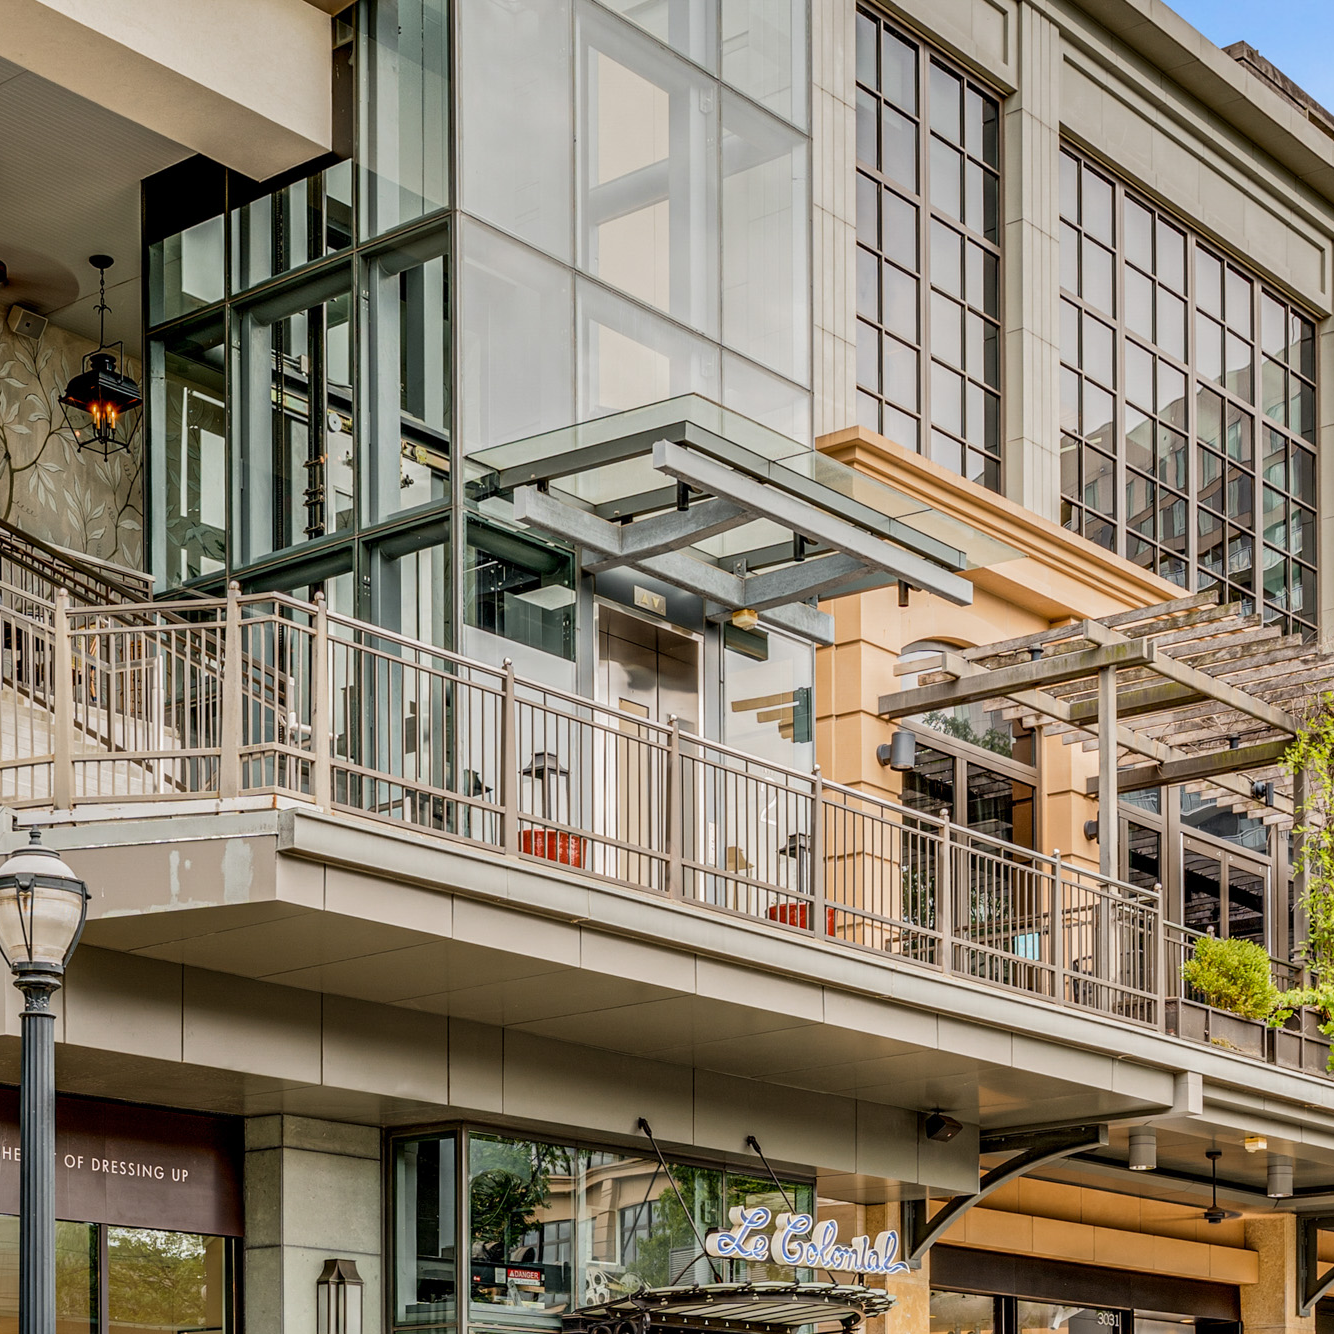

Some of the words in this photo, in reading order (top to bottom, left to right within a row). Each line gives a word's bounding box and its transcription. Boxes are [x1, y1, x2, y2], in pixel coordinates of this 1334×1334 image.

[64, 1154, 84, 1169] OF
[91, 1158, 165, 1180] DRESSING
[171, 1168, 189, 1182] UP
[706, 1205, 772, 1261] Le
[771, 1213, 911, 1275] Colonial
[514, 1270, 539, 1279] DANGER
[1097, 1312, 1120, 1328] 3031
